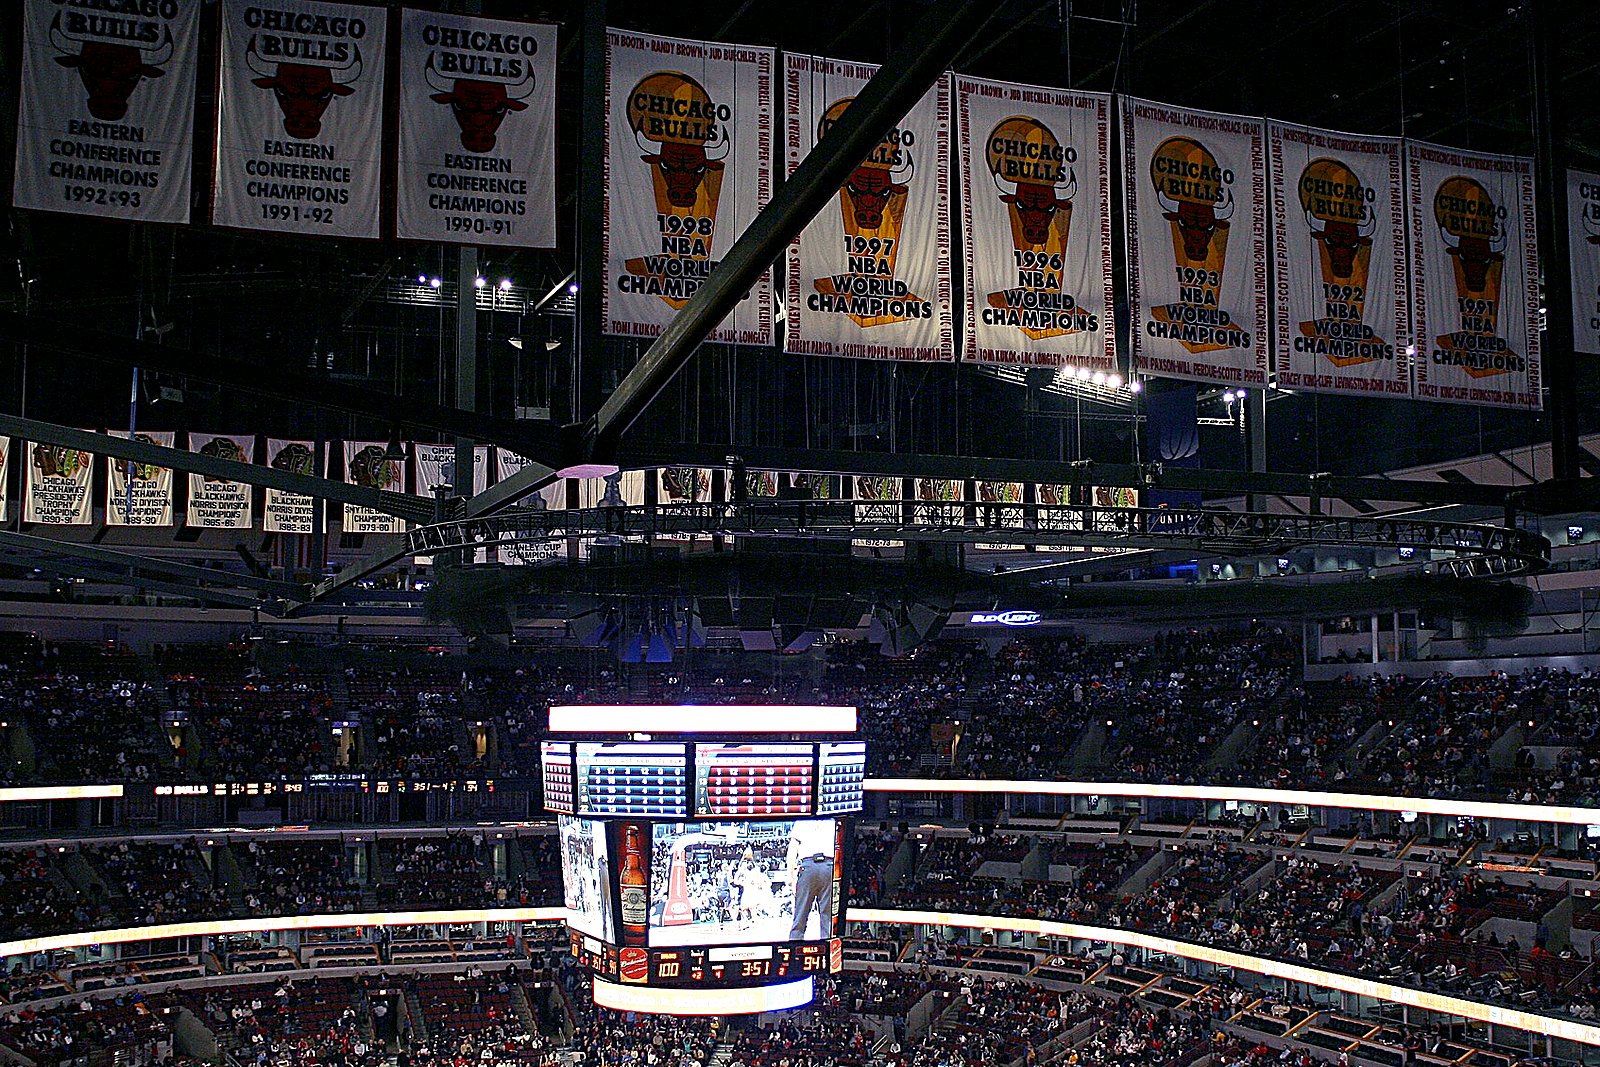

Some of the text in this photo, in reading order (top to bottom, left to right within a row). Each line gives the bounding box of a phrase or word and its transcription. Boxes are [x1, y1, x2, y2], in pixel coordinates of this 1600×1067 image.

[54, 0, 178, 19] ICAGO
[66, 11, 160, 43] BULLS
[244, 6, 367, 39] CHICAGO
[263, 34, 349, 62] BULLS
[423, 25, 538, 57] CHICAGO
[621, 34, 645, 50] BOOTH
[651, 39, 703, 58] RANDY BROWN
[709, 47, 723, 60] JUD
[440, 51, 522, 78] BULLS
[788, 69, 799, 115] WILLIAMS
[633, 93, 731, 121] CHICAGO
[69, 119, 144, 142] EASTERN
[650, 118, 718, 141] BULLS
[788, 118, 800, 148] BRIAN
[50, 139, 161, 166] CONFERENCE
[264, 140, 334, 161] EASTERN
[992, 137, 1078, 163] CHICAGO
[246, 160, 351, 183] CONFERENCE
[444, 153, 512, 174] EASTERN
[1006, 158, 1066, 182] BULLS
[1155, 157, 1235, 184] CHICAGO
[1272, 139, 1284, 186] WILLIAMS
[50, 161, 159, 188] CHAMPIONS
[427, 172, 527, 195] CONFERENCE
[65, 185, 141, 208] 1992-93
[247, 182, 349, 205] CHAMPIONS
[1169, 178, 1225, 202] BULLS
[1303, 177, 1376, 202] CHICAGO
[261, 204, 333, 224] 1991-92
[429, 194, 526, 216] CHAMPIONS
[1314, 198, 1367, 220] BULLS
[1438, 195, 1507, 220] CHICAGO
[444, 216, 511, 235] 1990-91
[657, 214, 713, 235] 1998
[1451, 214, 1498, 236] BULLS
[662, 236, 708, 257] NBA
[844, 235, 895, 256] 1997
[849, 257, 891, 276] NBA
[1014, 250, 1063, 270] 1996
[831, 276, 908, 298] WORLD
[1019, 271, 1059, 289] NBA
[1176, 266, 1219, 287] 1993
[1003, 289, 1074, 310] WORLD
[1180, 287, 1217, 307] NBA
[1322, 284, 1364, 302] 1992
[807, 294, 932, 319] CHAMPIONS
[1165, 304, 1230, 326] WORLD
[1326, 303, 1360, 320] NBA
[1458, 297, 1495, 315] 1991
[982, 308, 1098, 332] CHAMPIONS
[1313, 320, 1374, 340] WORLD
[1462, 315, 1494, 333] NBA
[1146, 321, 1251, 349] CHAMPIONS
[1450, 332, 1507, 351] WORLD
[1294, 337, 1394, 360] CHAMPIONS
[1432, 350, 1526, 373] CHAMPIONS
[32, 484, 85, 494] BLACKHAWKS
[42, 477, 76, 486] CHICAGO
[124, 481, 157, 489] CICAGO
[204, 484, 237, 492] CHICAGO
[42, 500, 73, 508] TROPHY
[110, 498, 170, 507] NORRS DIVISION
[190, 500, 249, 510] NORRIS DIVISION
[194, 492, 245, 501] BLACKHAWKS
[271, 496, 313, 506] BLACKHAW
[35, 507, 80, 516] CHAMPIONS
[118, 507, 162, 516] CHMPIONS
[123, 516, 156, 524] 189-90
[198, 509, 240, 518] CHAMPIONS
[266, 505, 313, 514] NORRIS DIVIS
[275, 514, 312, 523] CHAMPION
[354, 515, 395, 523] CHAMPIONS
[504, 543, 561, 552] STANLEY CUP
[508, 551, 558, 559] CHAMPIONS
[971, 614, 998, 622] BUD
[658, 962, 680, 978] 100
[742, 961, 770, 976] 3:51
[803, 956, 820, 971] 94
